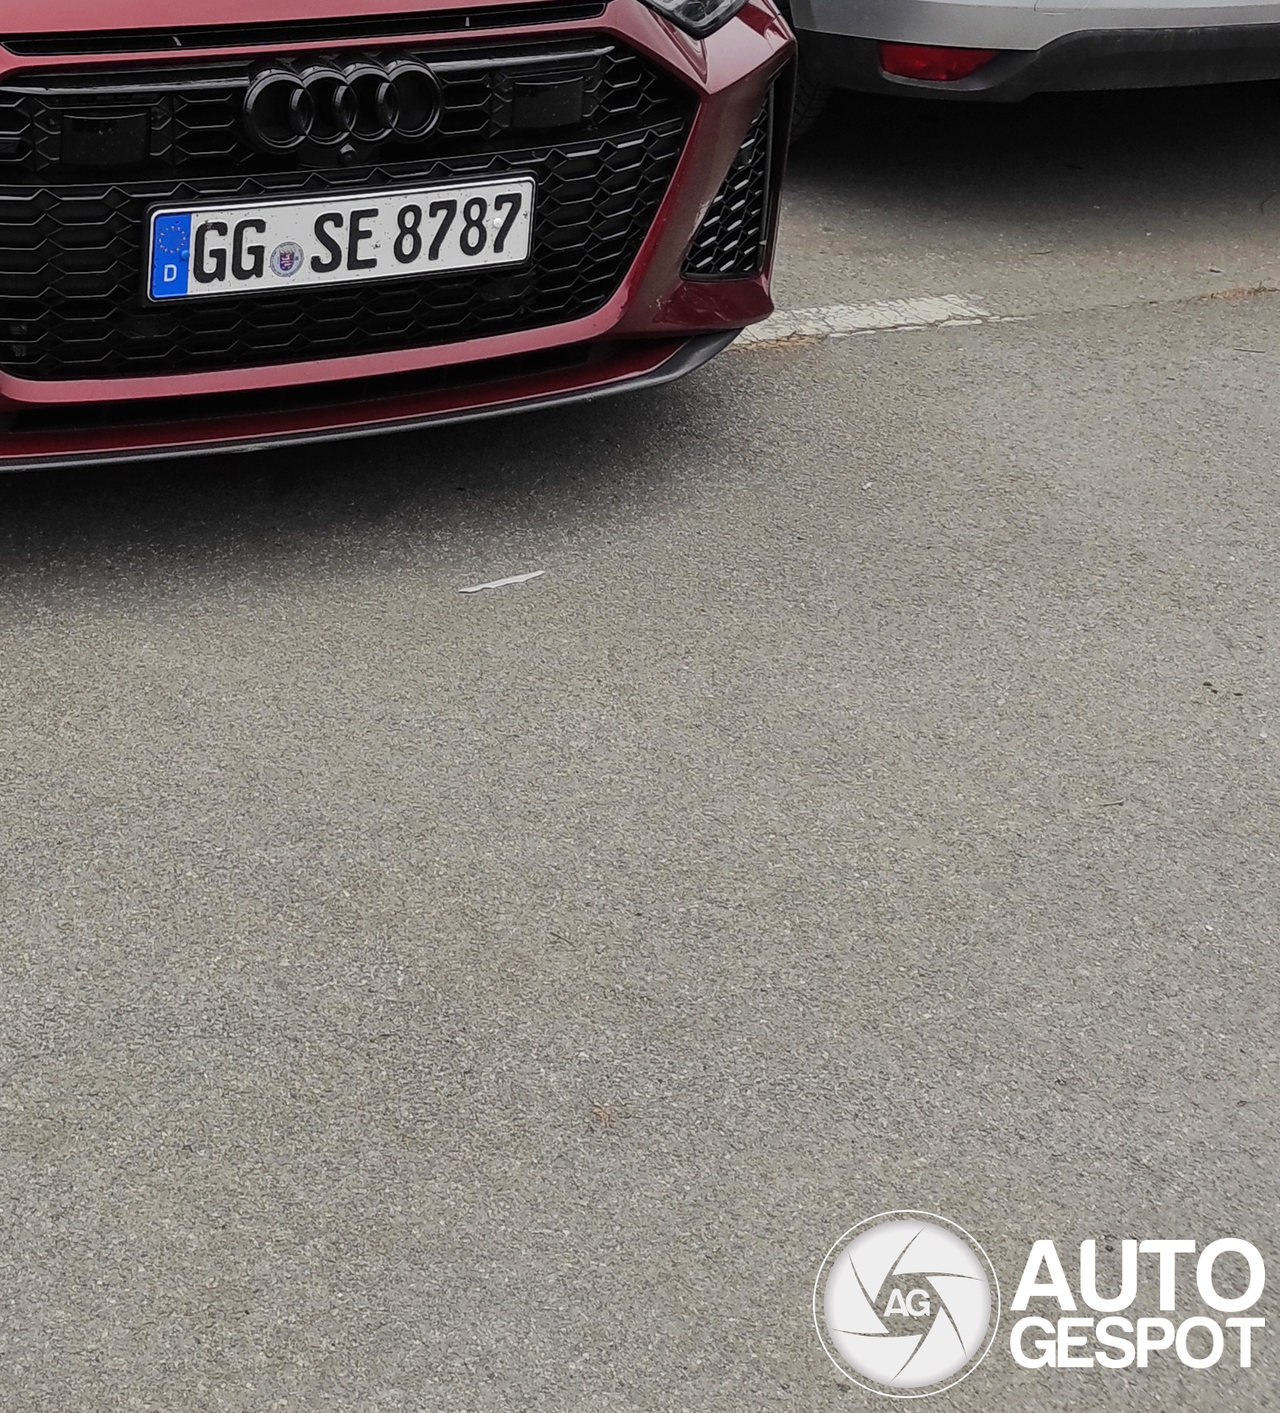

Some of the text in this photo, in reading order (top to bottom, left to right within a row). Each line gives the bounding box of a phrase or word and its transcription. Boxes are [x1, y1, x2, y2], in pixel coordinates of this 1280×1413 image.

[193, 218, 267, 284] GG
[310, 208, 379, 273] SE
[393, 192, 522, 264] 8787
[163, 263, 177, 283] D
